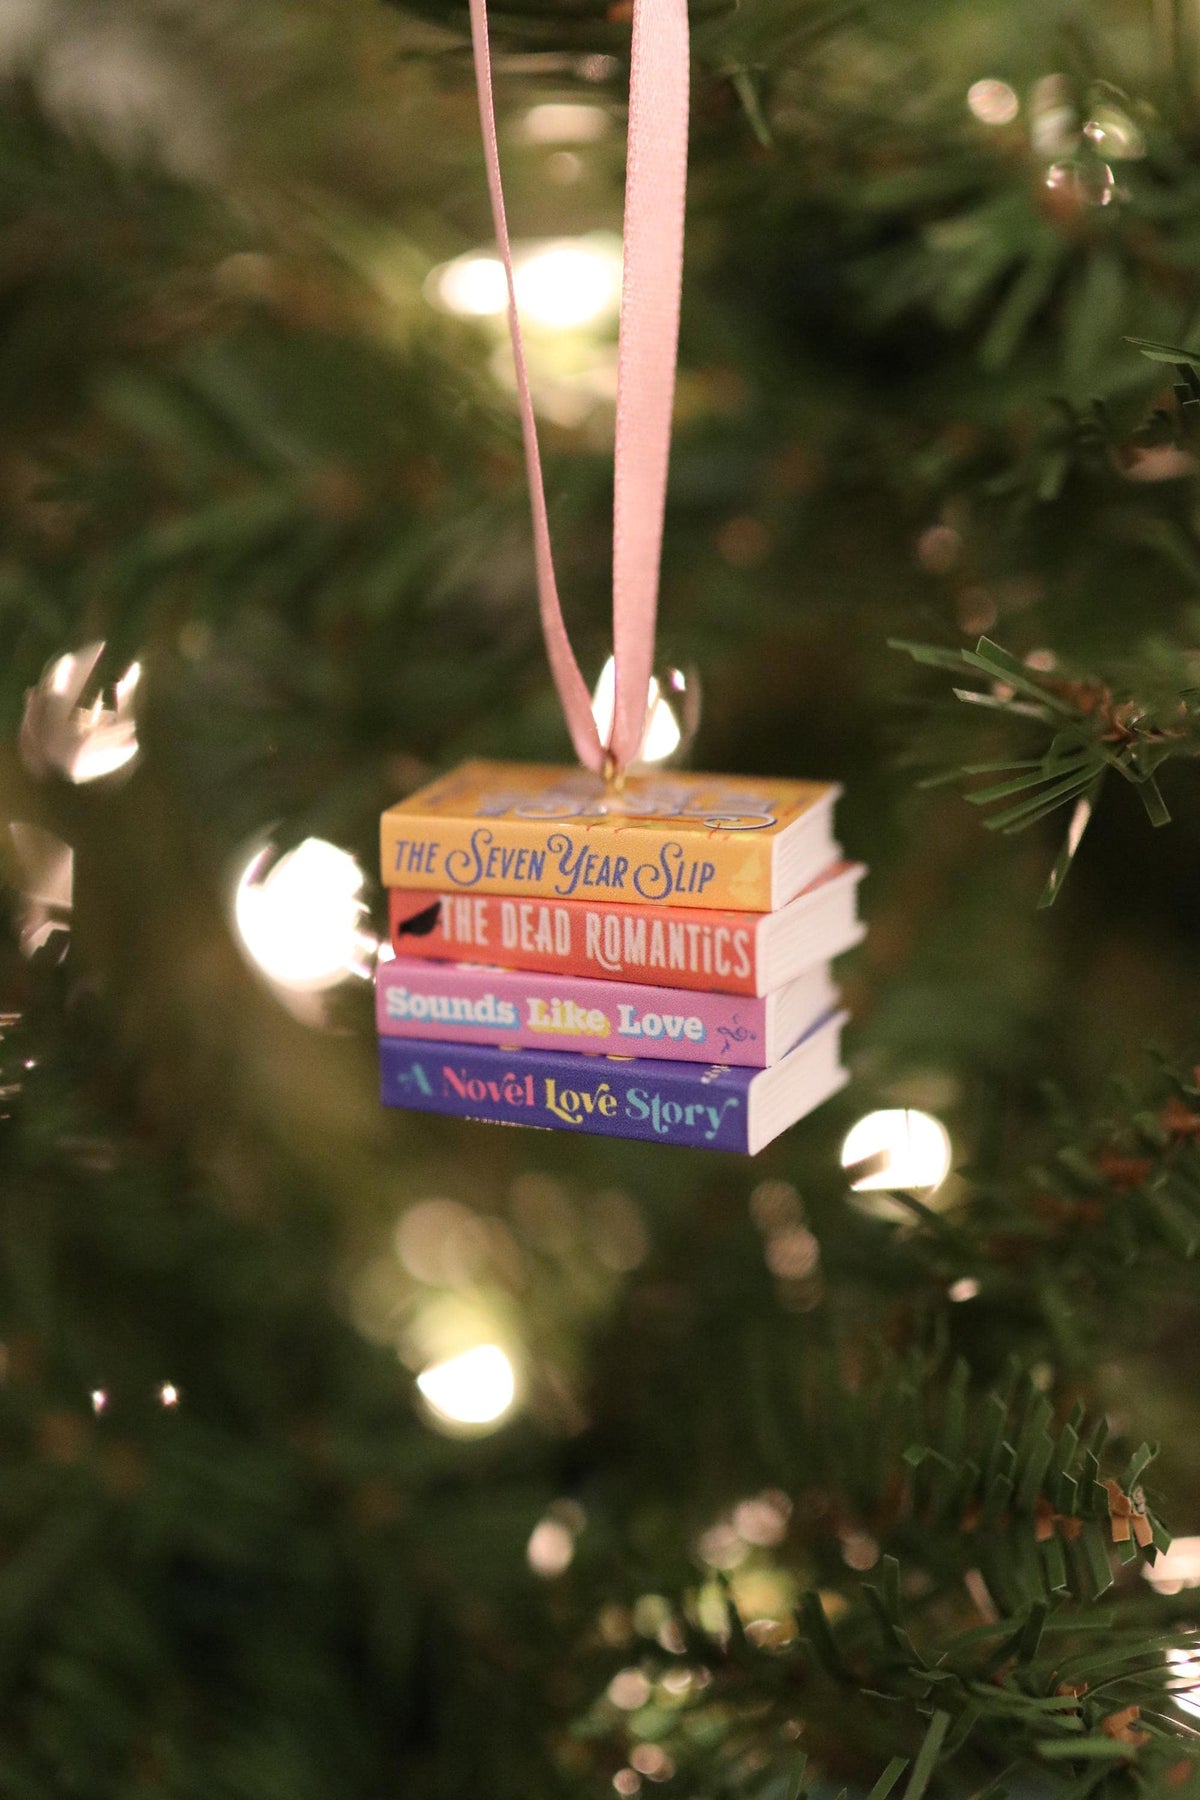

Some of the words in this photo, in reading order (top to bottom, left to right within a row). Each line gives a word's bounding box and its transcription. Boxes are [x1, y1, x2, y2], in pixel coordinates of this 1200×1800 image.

[395, 840, 440, 874] THE
[440, 895, 489, 946] THE
[501, 901, 571, 957] DEAD
[386, 986, 520, 1031] Sounds
[526, 996, 611, 1041] Like
[616, 1003, 707, 1044] Love
[397, 1061, 433, 1097] A
[442, 1065, 536, 1107] Novel
[544, 1078, 618, 1125] Love
[625, 1087, 740, 1140] Story
